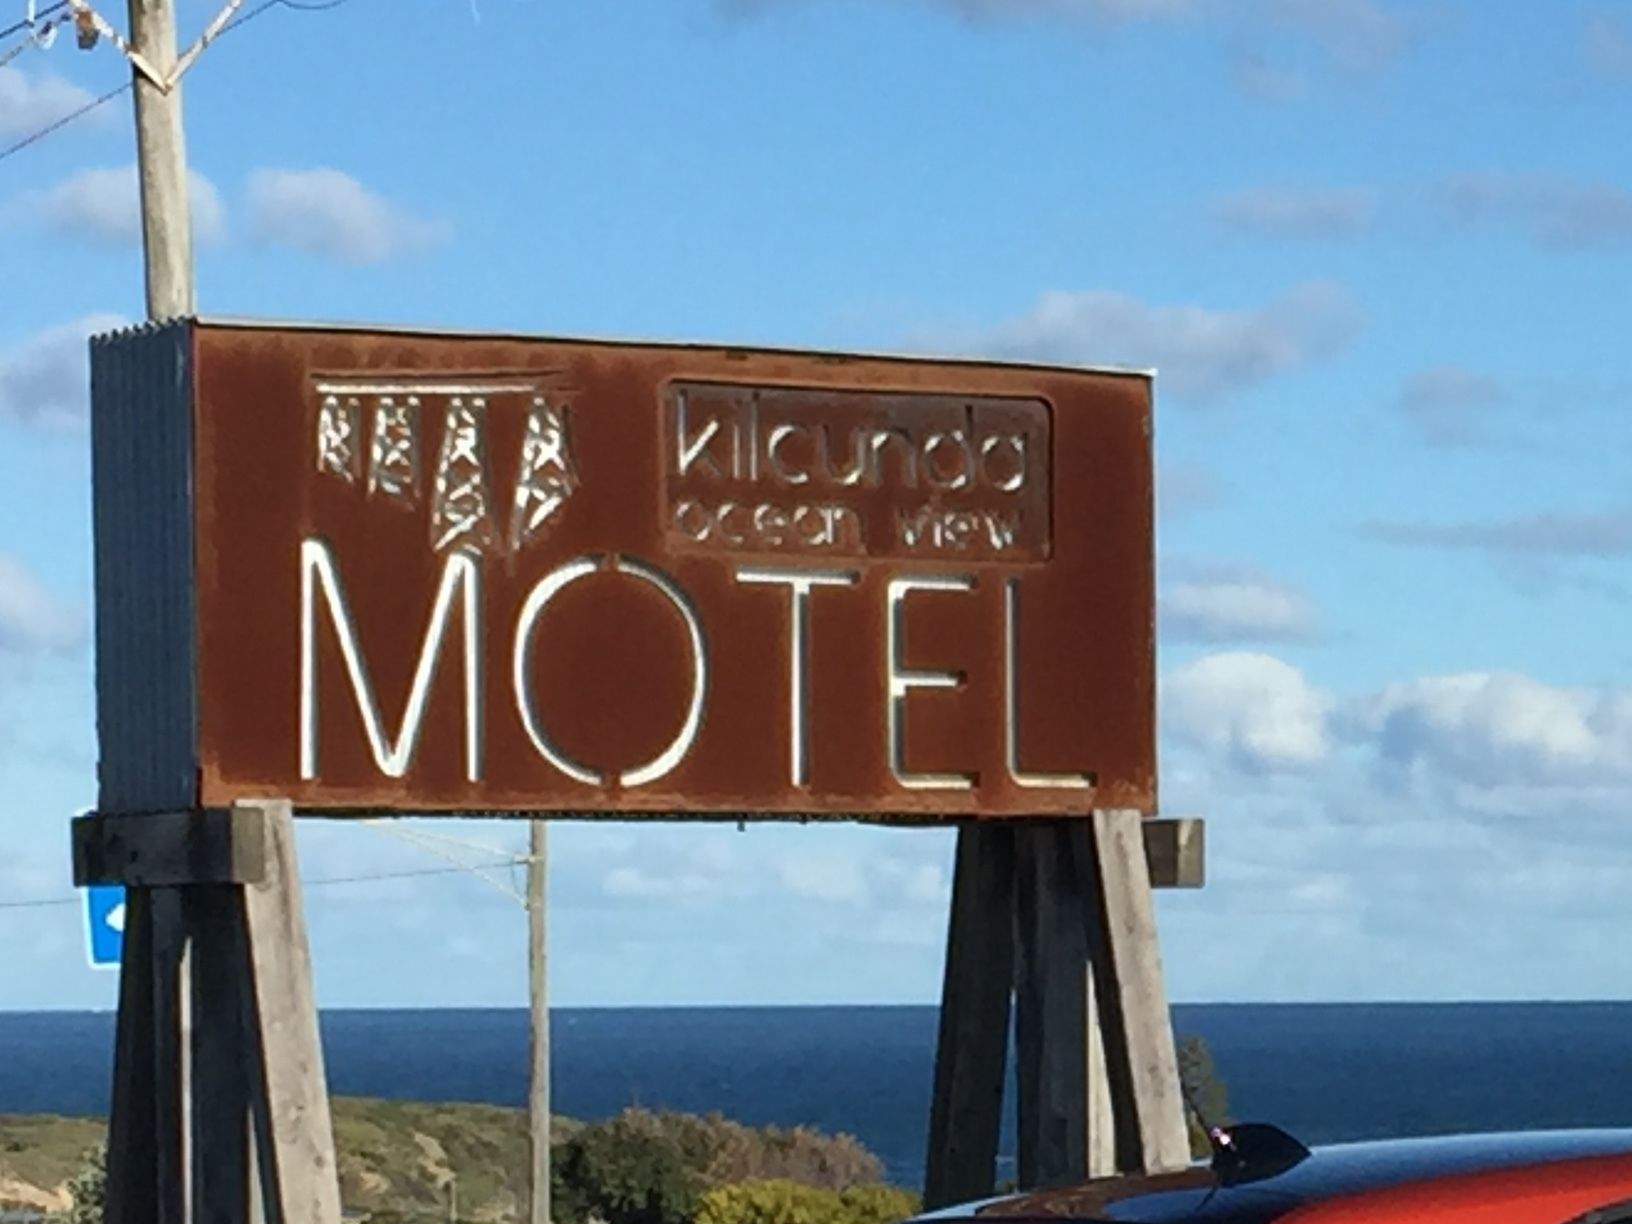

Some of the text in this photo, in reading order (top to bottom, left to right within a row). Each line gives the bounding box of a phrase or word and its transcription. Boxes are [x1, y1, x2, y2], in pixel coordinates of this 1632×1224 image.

[676, 388, 1029, 492] kilcunda
[674, 501, 1022, 551] ocean view
[300, 538, 1096, 788] MOTEL
